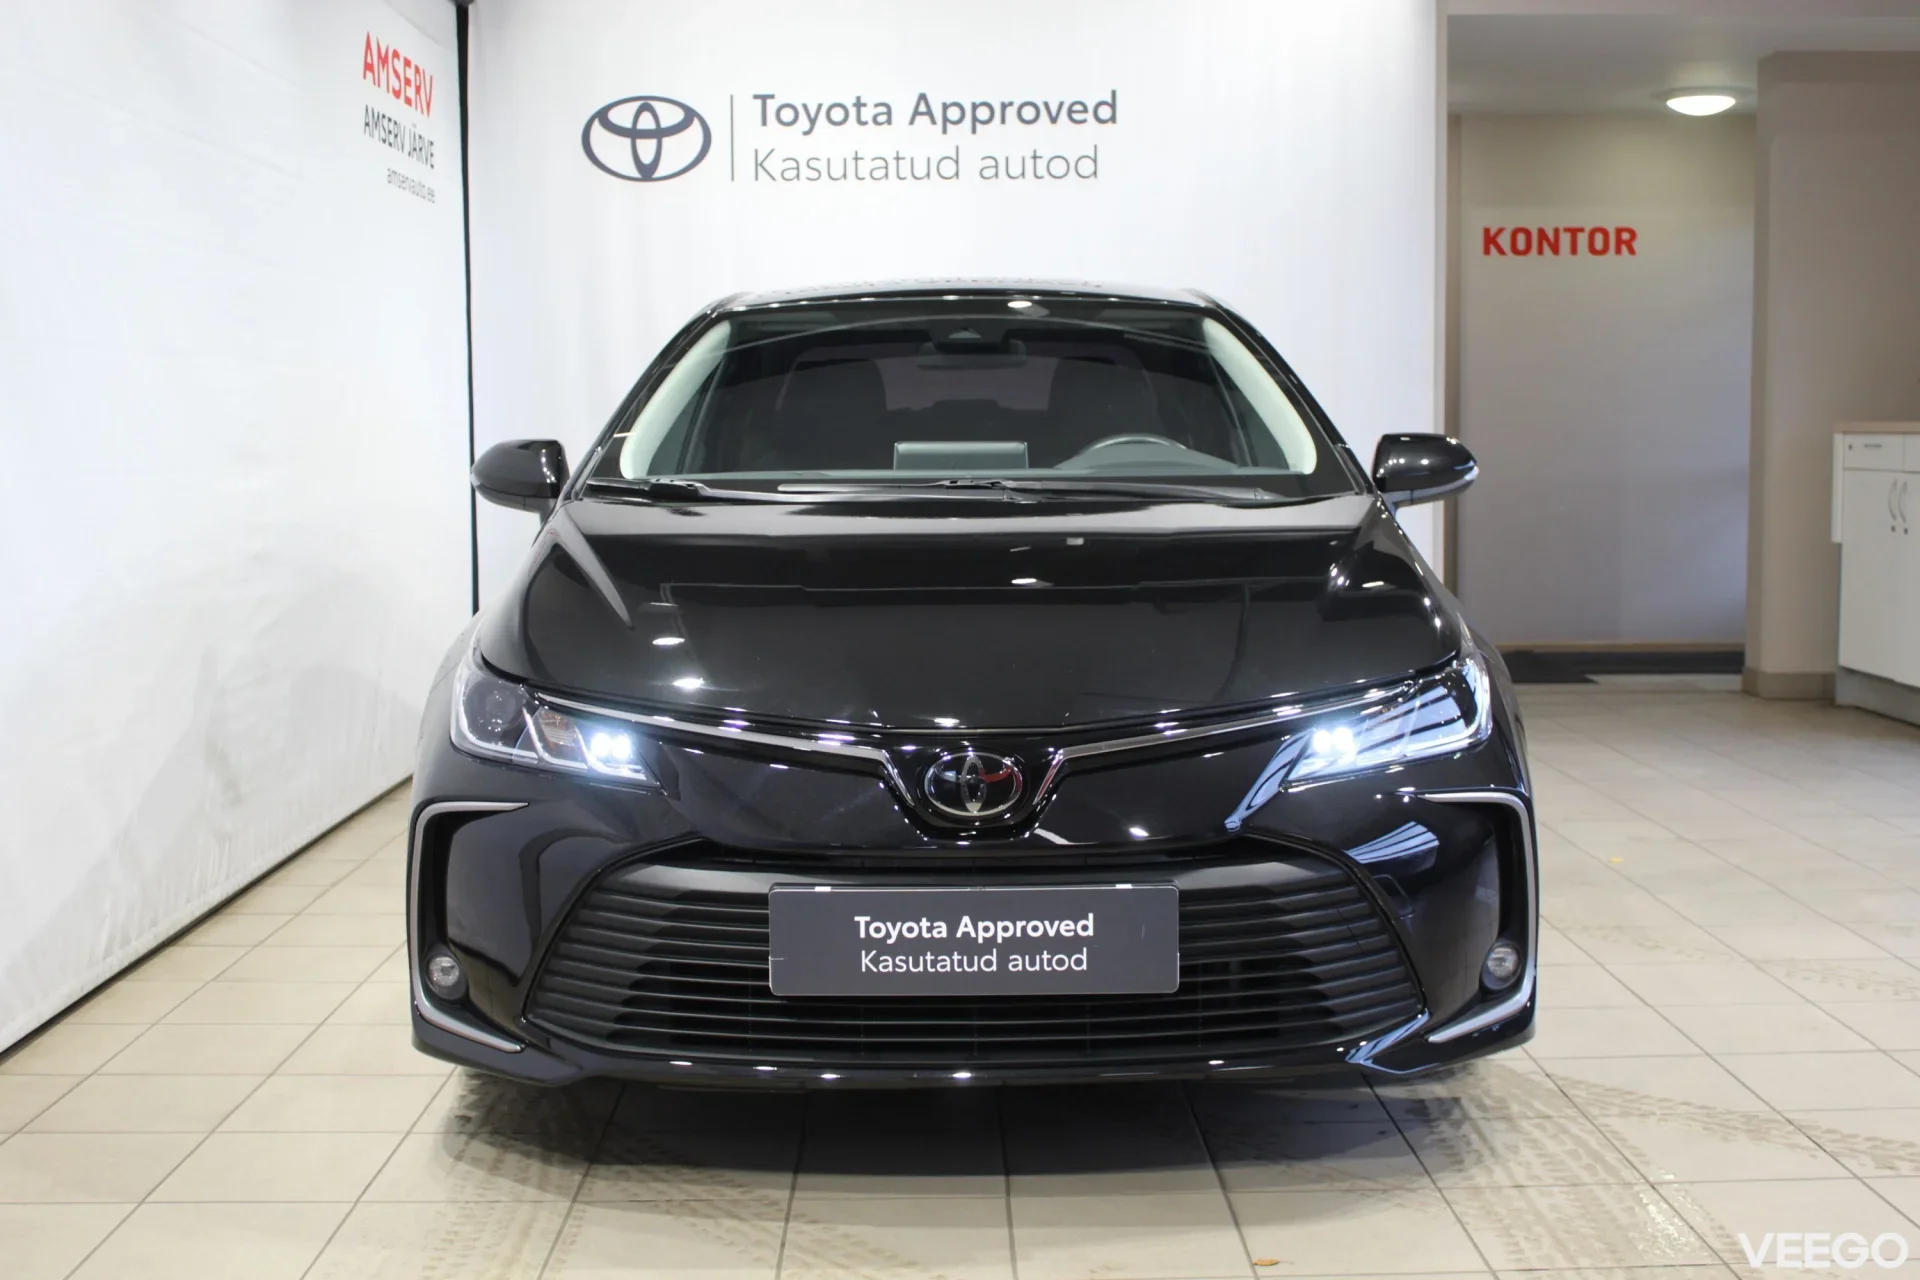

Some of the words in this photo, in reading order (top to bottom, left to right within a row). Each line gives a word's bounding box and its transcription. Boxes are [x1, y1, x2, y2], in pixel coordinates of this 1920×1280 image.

[362, 30, 434, 119] AMSERV
[753, 93, 893, 135] Toyota
[908, 90, 1118, 135] Approved
[363, 104, 407, 154] AMSERV
[407, 122, 435, 169] JÄRVE
[753, 145, 961, 182] Kasutatud
[978, 144, 1099, 181] autod
[1482, 226, 1637, 257] KONTOR
[854, 915, 948, 945] Toyota
[955, 912, 1095, 944] Approved
[861, 948, 997, 973] Kasutatud
[1008, 947, 1088, 972] autod
